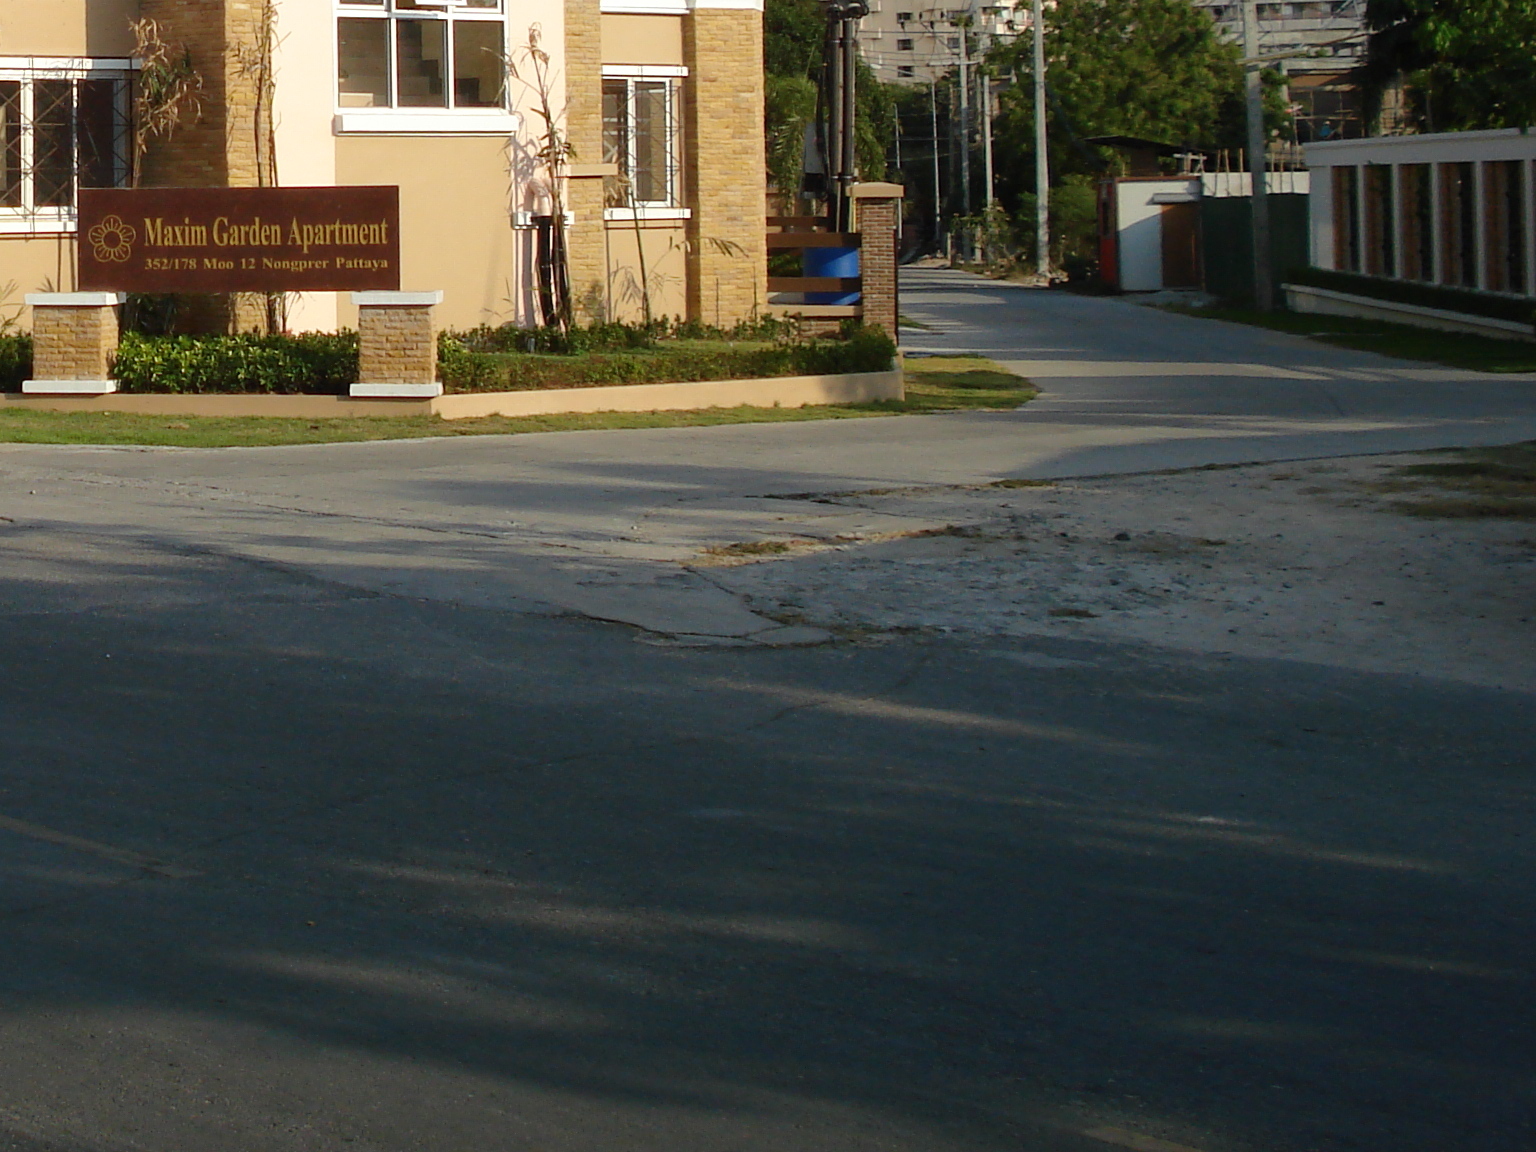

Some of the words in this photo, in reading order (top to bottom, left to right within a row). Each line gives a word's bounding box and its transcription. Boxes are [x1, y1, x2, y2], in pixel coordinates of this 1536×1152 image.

[144, 216, 208, 247] Maxim
[212, 216, 282, 247] Garden
[287, 217, 389, 254] Apartment
[144, 257, 197, 271] 352/178
[203, 257, 234, 270] Moo
[240, 257, 256, 270] 12
[335, 256, 389, 272] Pattaya
